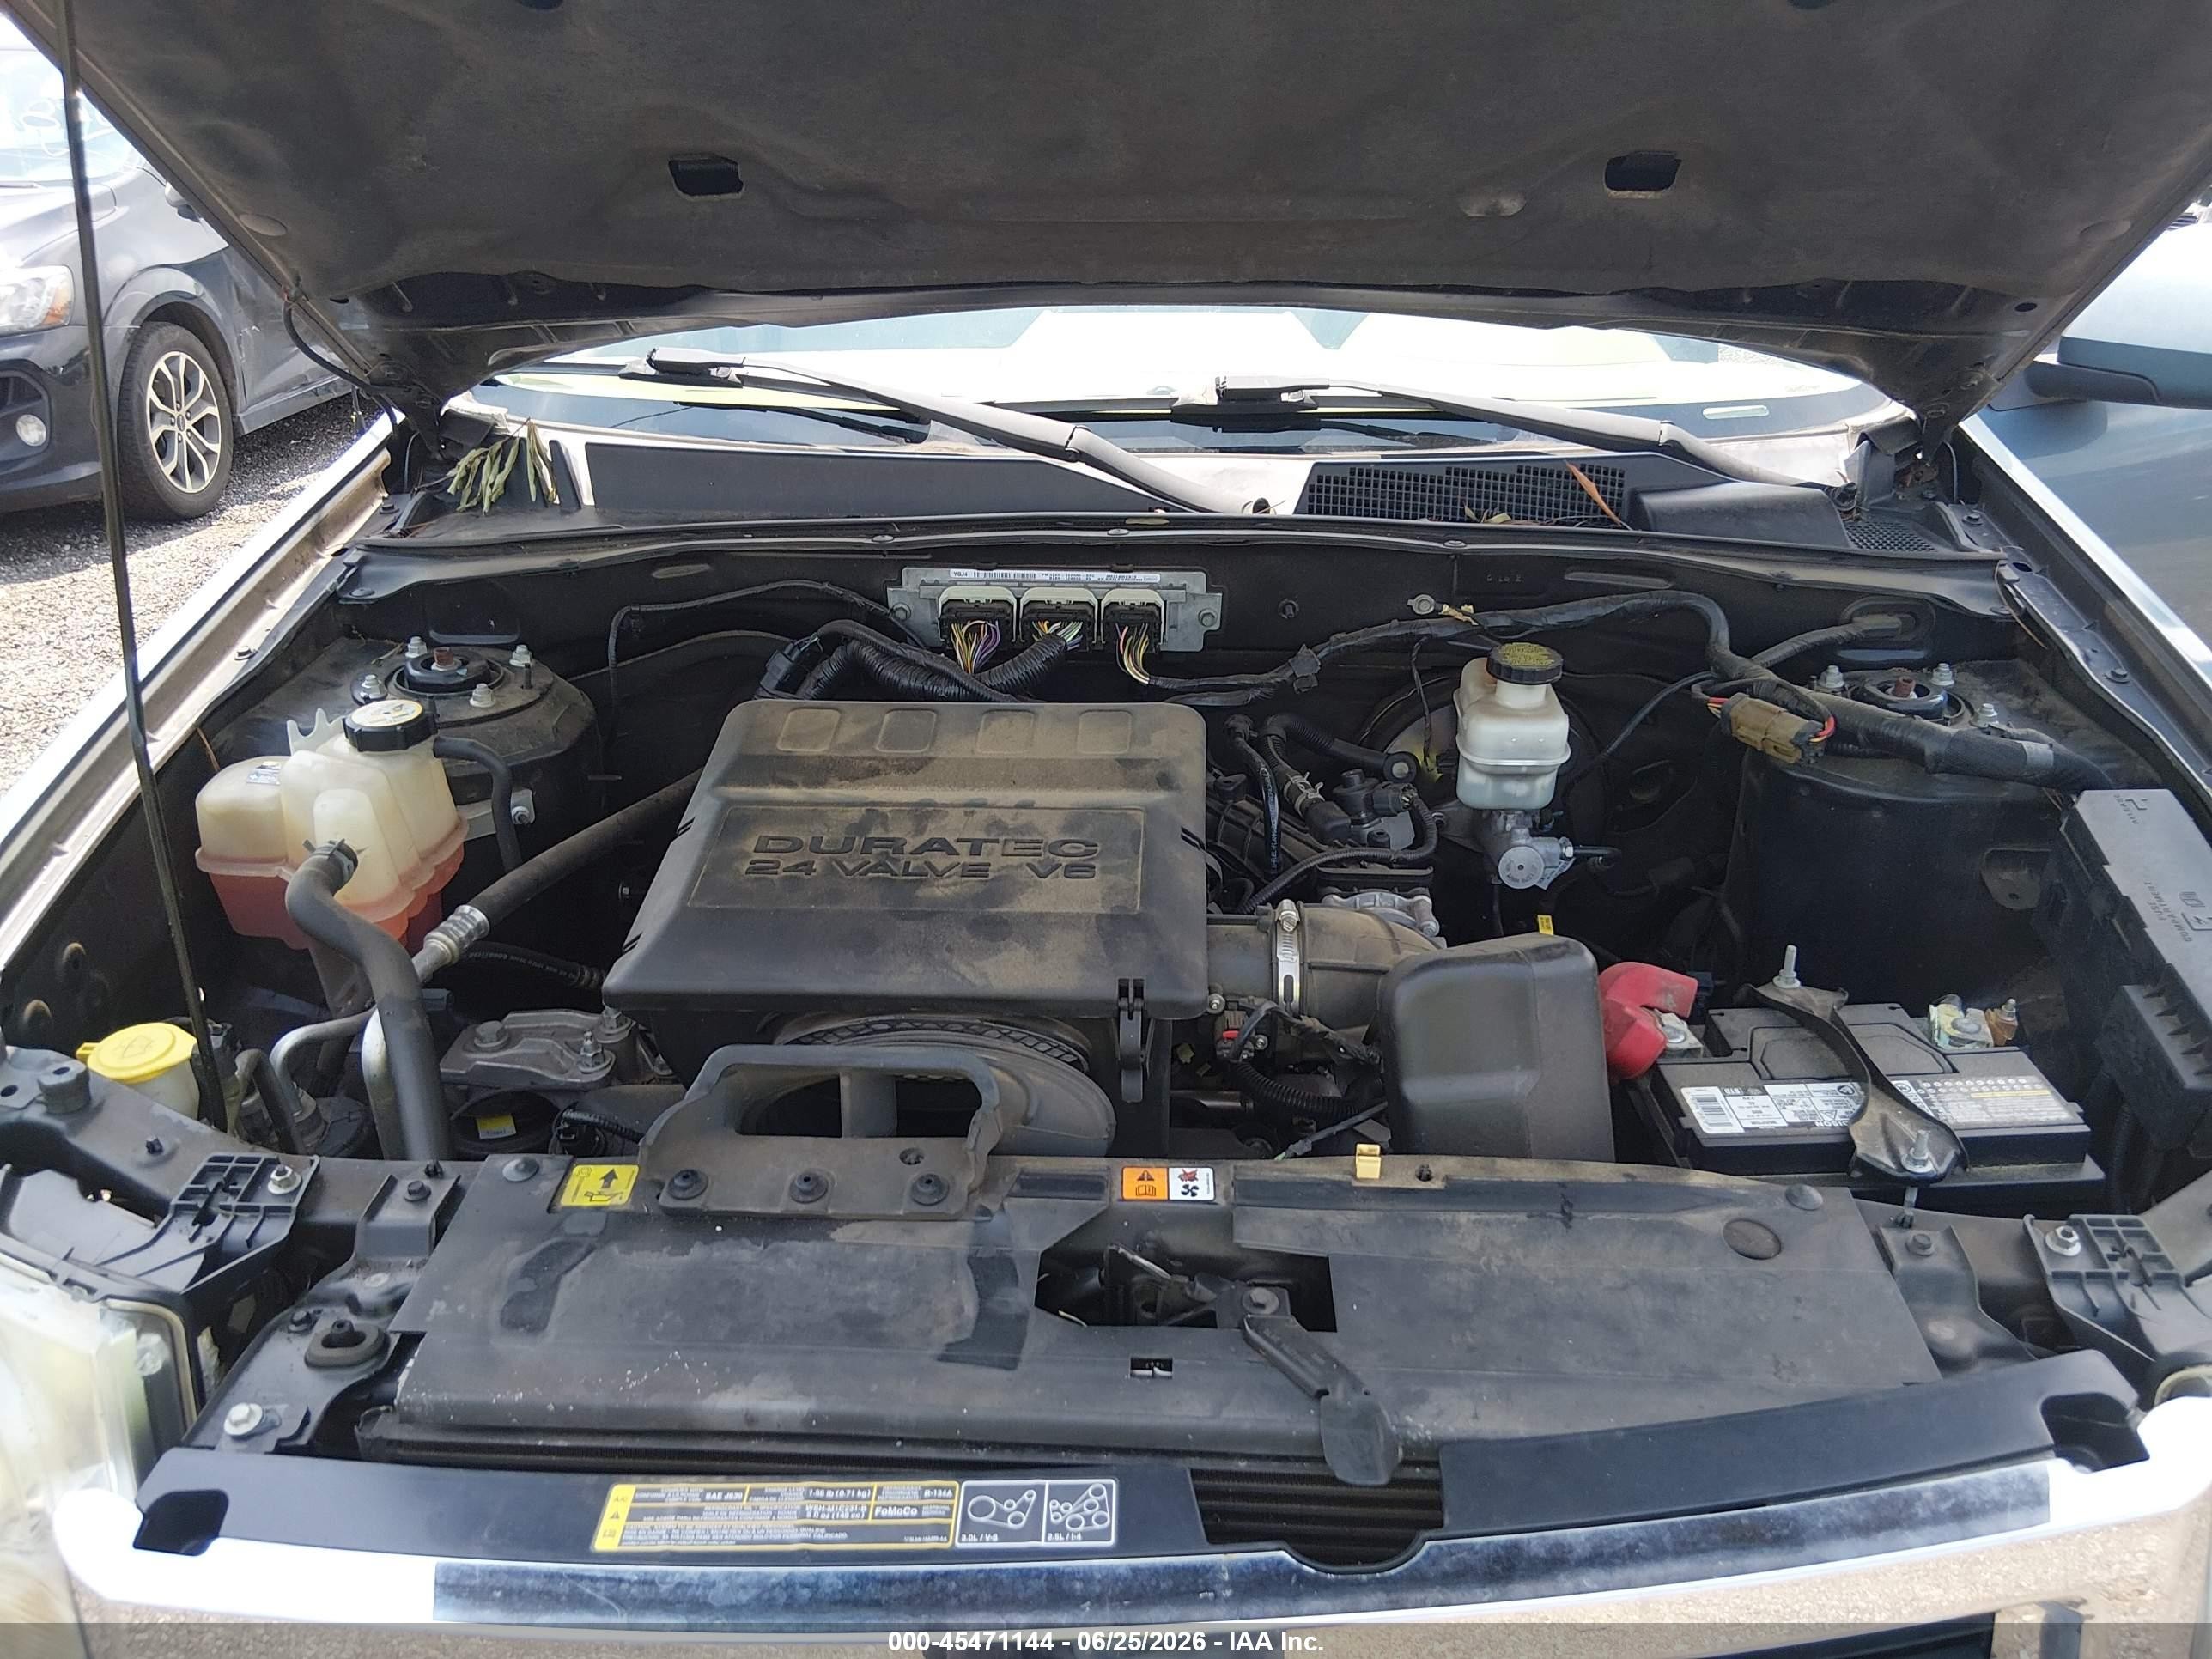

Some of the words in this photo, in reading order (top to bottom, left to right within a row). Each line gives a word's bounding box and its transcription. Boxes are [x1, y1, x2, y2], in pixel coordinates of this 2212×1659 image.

[753, 835, 1099, 857] DURATEC
[744, 859, 817, 876] 24
[831, 860, 991, 878] VALVE
[1025, 862, 1097, 879] V6
[705, 1492, 722, 1500] SAE
[874, 1506, 918, 1517] FoMoCo
